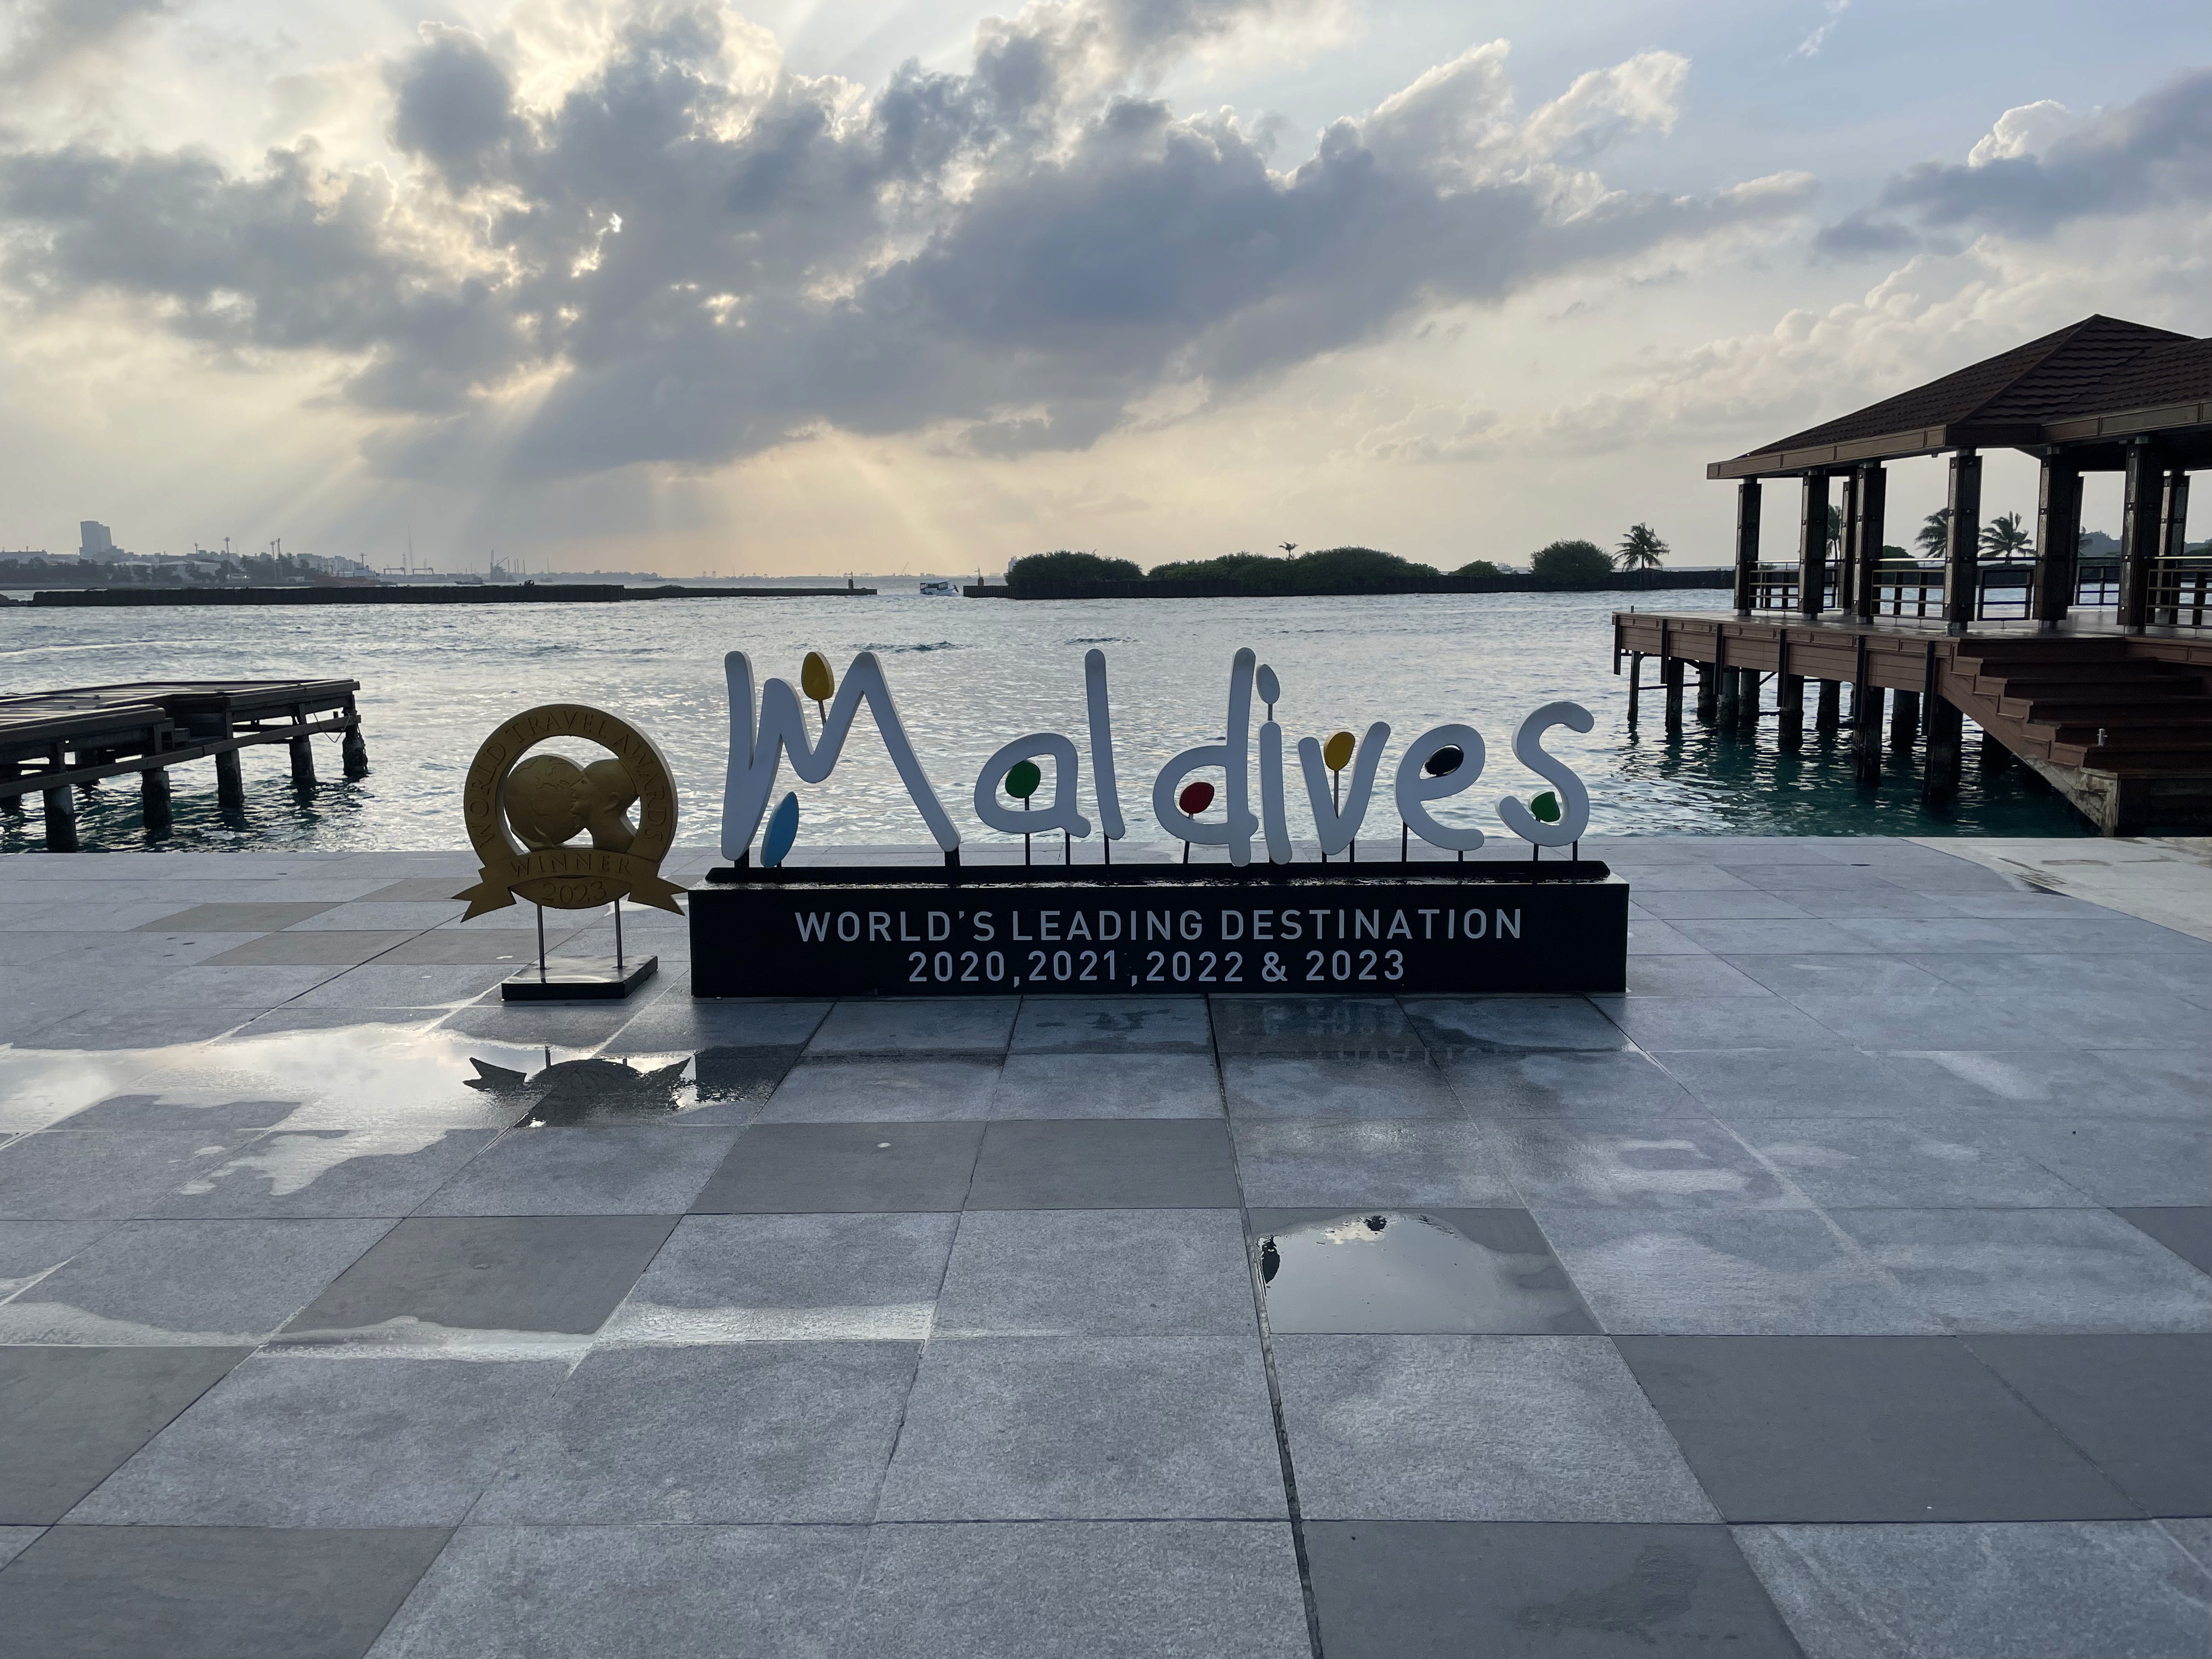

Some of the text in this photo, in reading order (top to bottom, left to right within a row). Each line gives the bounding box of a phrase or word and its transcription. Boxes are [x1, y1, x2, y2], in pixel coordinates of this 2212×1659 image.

[721, 647, 1594, 868] Maldives
[469, 710, 667, 848] WORLD TRAVEL AWARDS
[510, 853, 633, 878] WINNER
[541, 881, 606, 905] 2023
[794, 909, 1521, 942] WORLD'S LEADING DESTINATION
[1262, 951, 1288, 982] &
[1306, 949, 1403, 981] 2023
